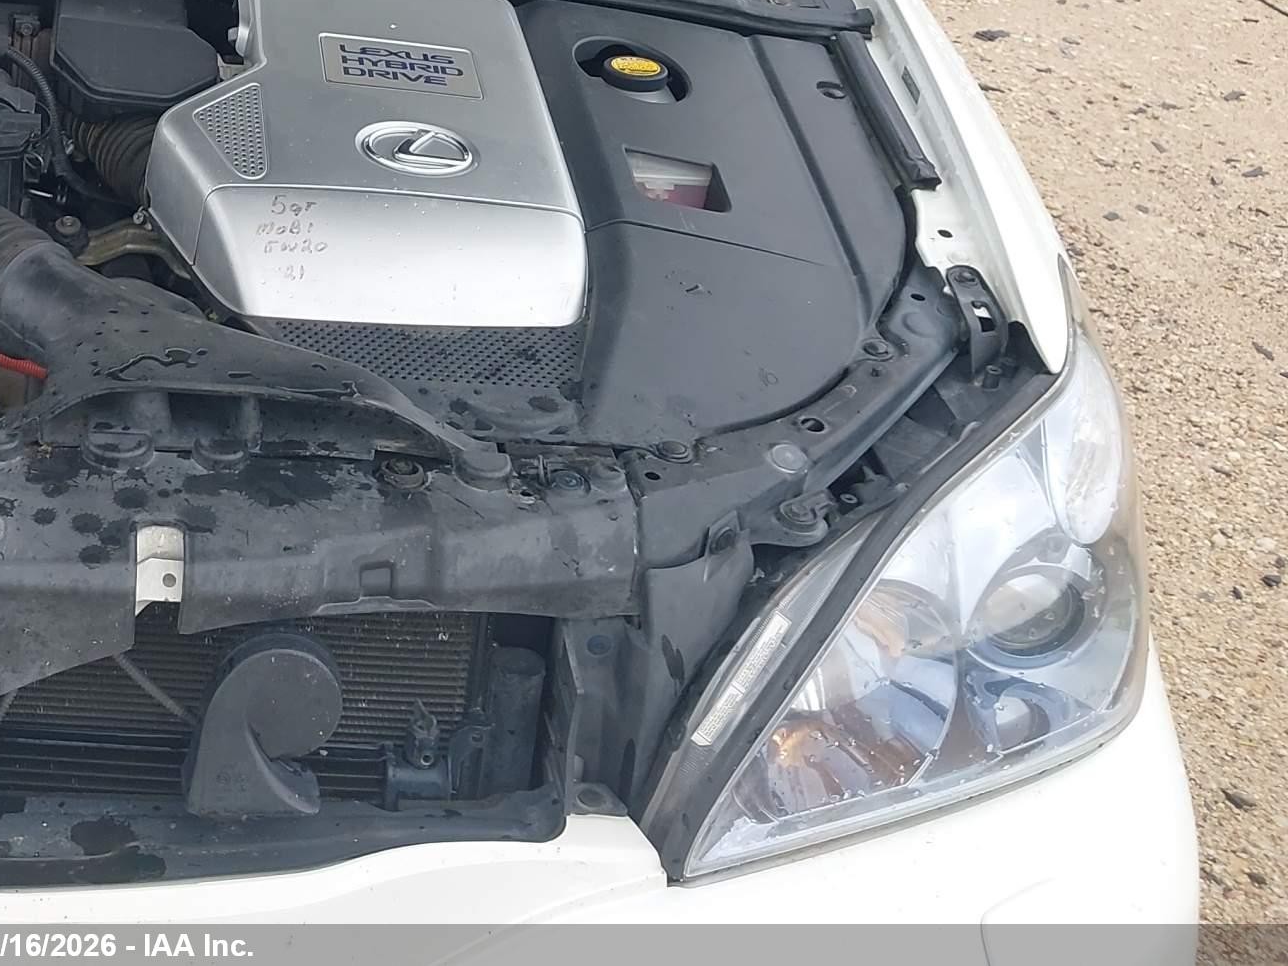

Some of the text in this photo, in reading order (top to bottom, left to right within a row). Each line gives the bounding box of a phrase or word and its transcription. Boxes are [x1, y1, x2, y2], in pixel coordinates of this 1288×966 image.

[339, 44, 455, 65] LEXUS
[341, 55, 464, 77] HYBRID
[343, 66, 448, 86] DRIVE
